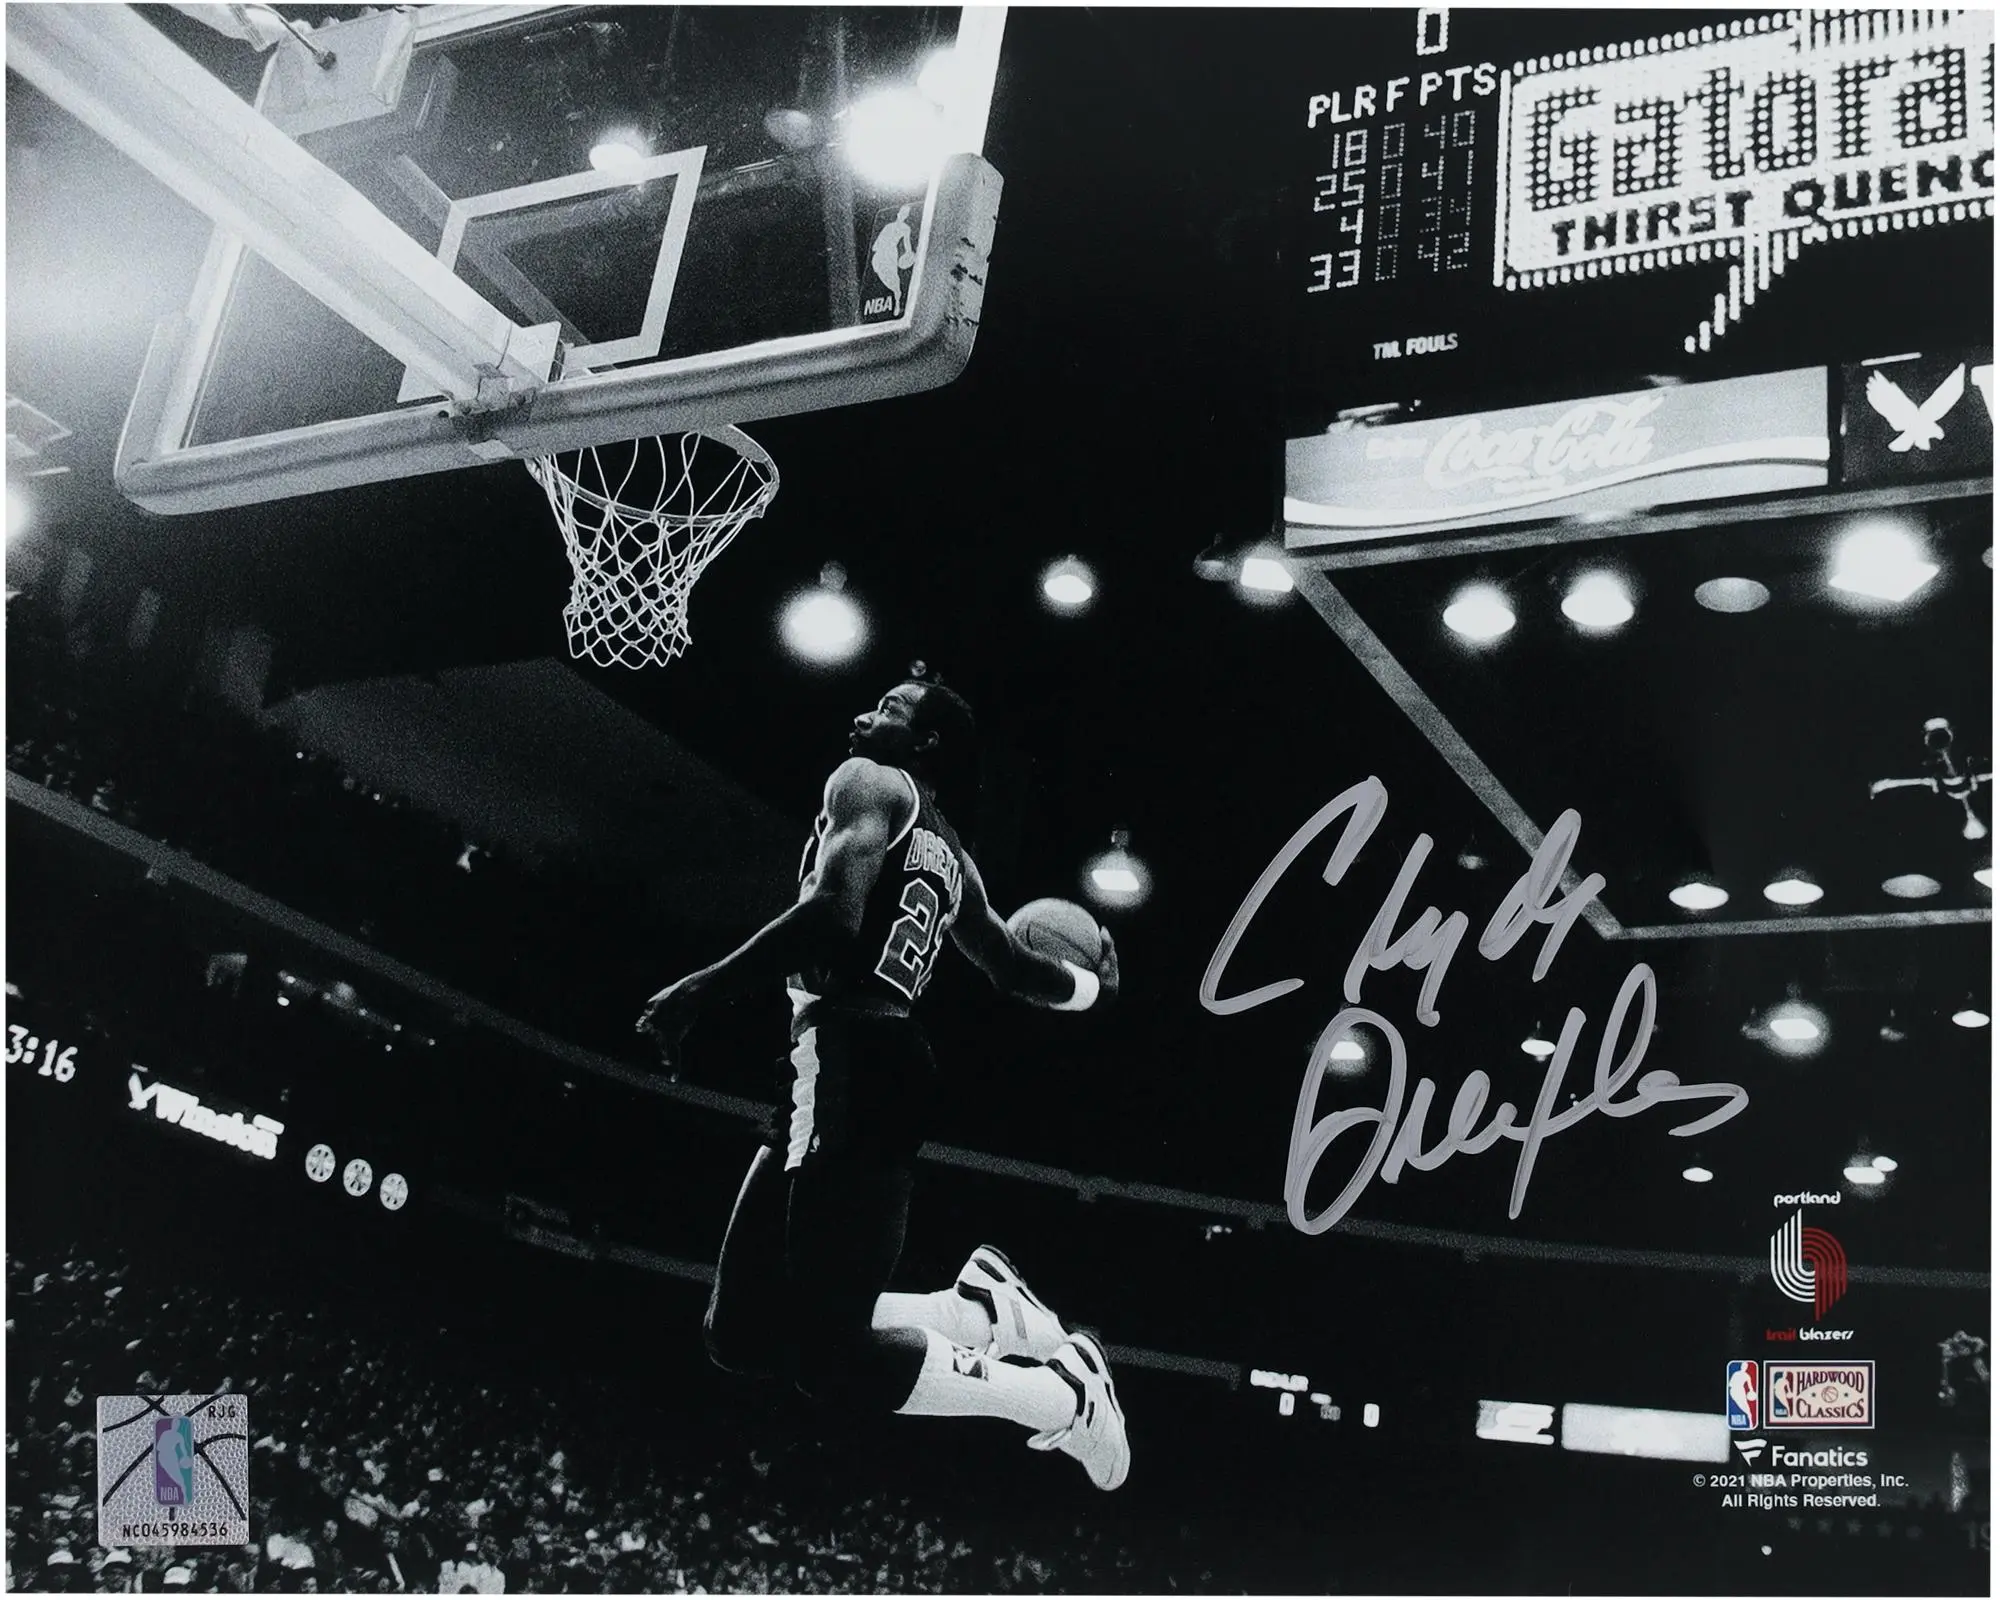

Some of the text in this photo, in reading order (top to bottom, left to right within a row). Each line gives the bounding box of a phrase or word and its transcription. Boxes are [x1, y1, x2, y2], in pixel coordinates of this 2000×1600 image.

[1307, 62, 1497, 128] PLR F PTS
[1332, 110, 1476, 169] 18 0 40
[1526, 46, 1994, 211] Gatora
[1313, 150, 1474, 212] 25 0 41
[1339, 191, 1472, 245] 4 0 34
[1551, 190, 1752, 257] THIRST
[1307, 231, 1471, 293] 33 0 42
[863, 295, 893, 316] NBA
[1406, 332, 1458, 356] FOULS
[6, 1024, 78, 1083] 3:16
[208, 1405, 236, 1419] RJG
[159, 1486, 180, 1502] NBA
